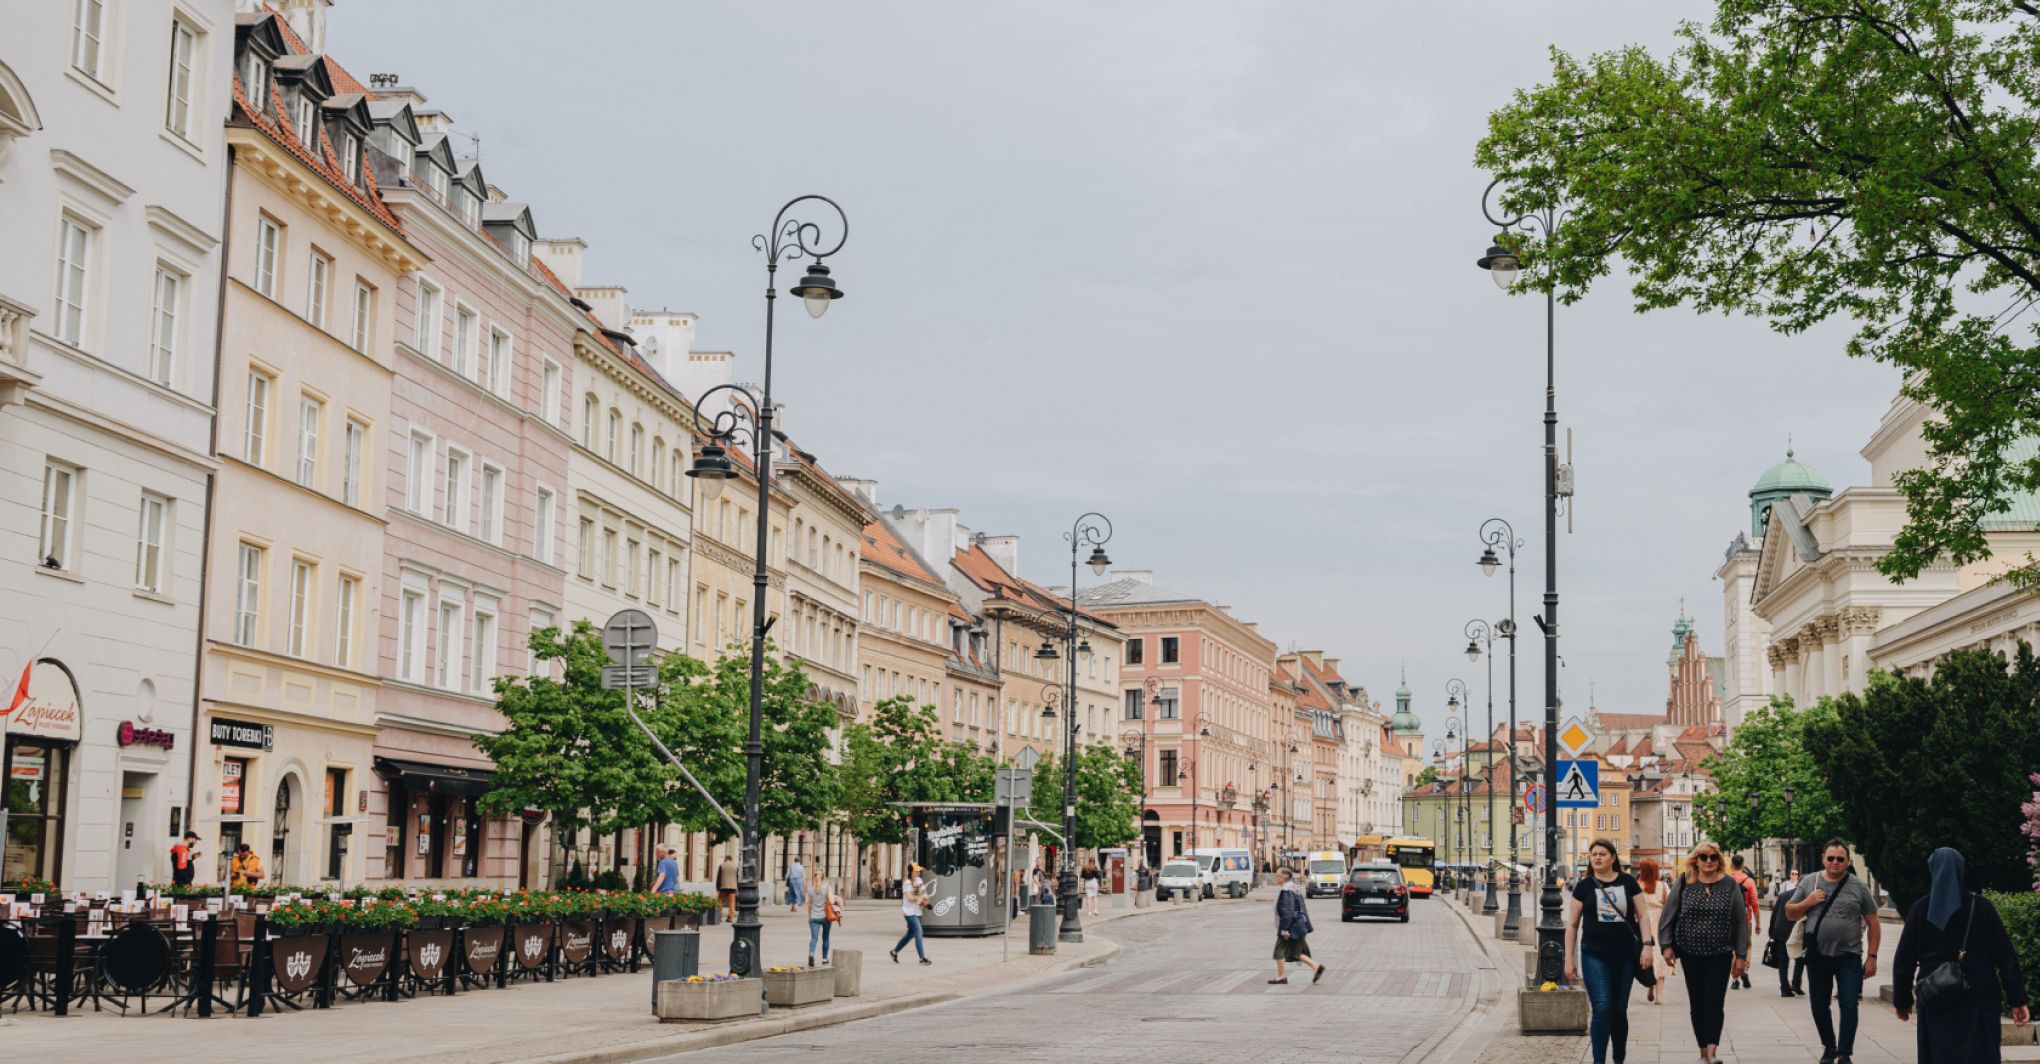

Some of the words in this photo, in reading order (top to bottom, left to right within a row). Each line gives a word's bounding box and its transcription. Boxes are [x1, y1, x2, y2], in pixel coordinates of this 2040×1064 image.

[14, 696, 75, 730] Zapiecek
[212, 723, 231, 741] BUTY
[232, 726, 262, 744] TOREBKI
[347, 947, 385, 970] Zapiecek
[470, 939, 497, 960] Zapiecek
